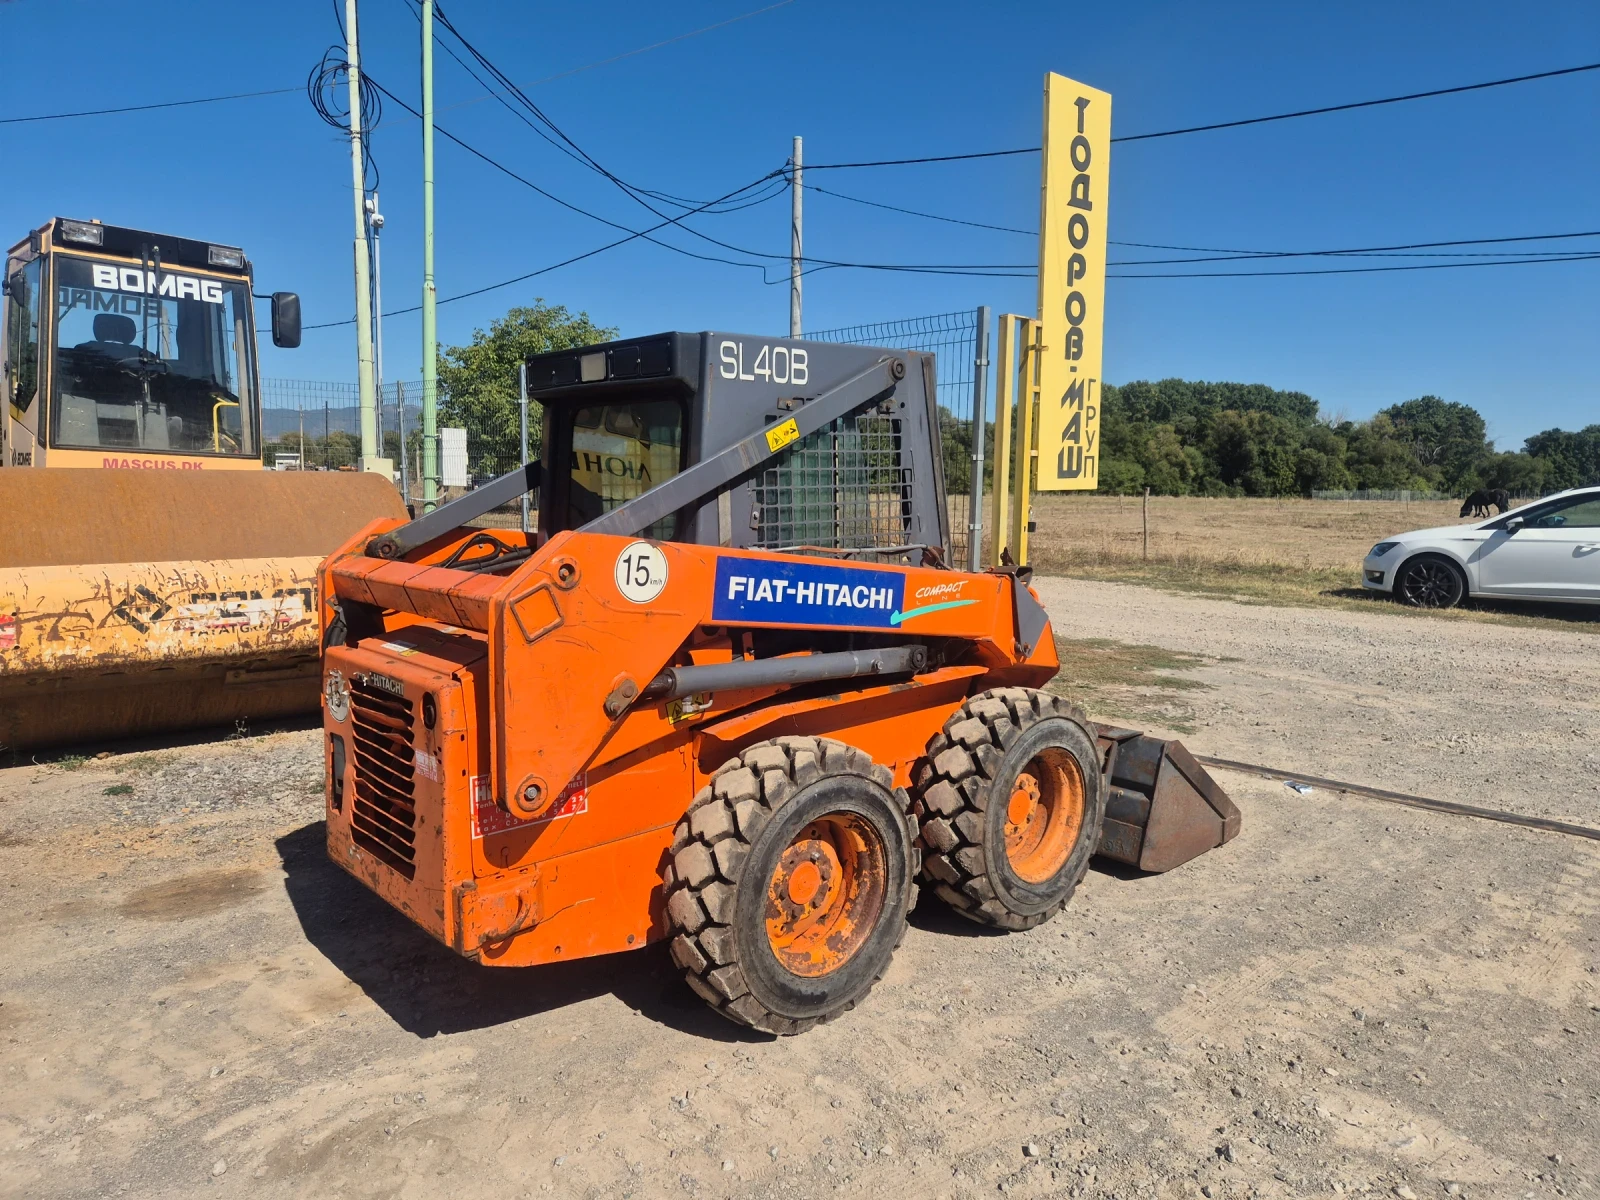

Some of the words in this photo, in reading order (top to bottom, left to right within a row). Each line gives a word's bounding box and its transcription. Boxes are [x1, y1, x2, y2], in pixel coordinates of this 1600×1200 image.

[92, 264, 223, 304] BOMAG
[720, 340, 808, 386] SL40B
[1083, 378, 1097, 479] ГРУП
[102, 458, 204, 470] MASCUS.DK
[622, 553, 650, 587] 15
[650, 578, 663, 586] km/h
[728, 575, 894, 610] FIAT-HITACHI
[915, 580, 969, 598] COMPACT
